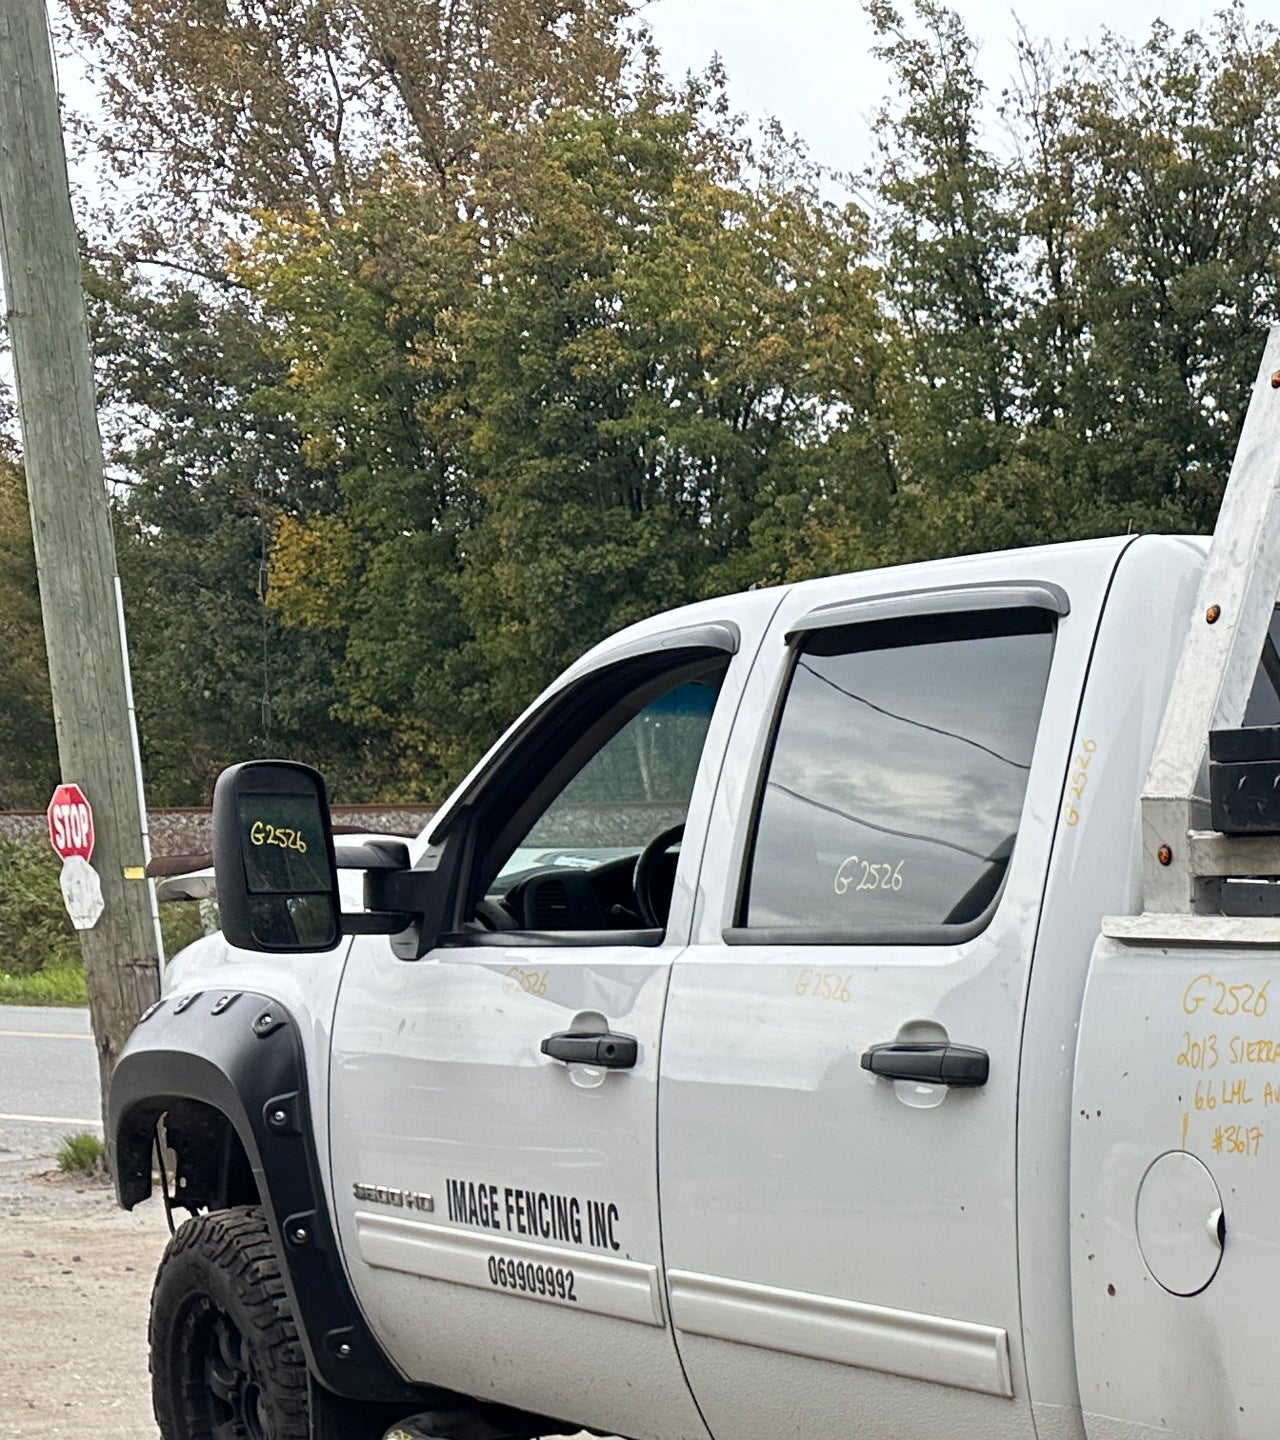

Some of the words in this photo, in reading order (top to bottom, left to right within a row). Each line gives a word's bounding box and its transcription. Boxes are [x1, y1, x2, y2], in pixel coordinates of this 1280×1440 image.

[1064, 738, 1097, 828] G2526
[53, 803, 89, 849] STOP
[250, 821, 307, 853] G2526
[833, 855, 903, 895] G2526
[1182, 974, 1271, 1017] G2526
[1176, 1031, 1219, 1070] 2013
[1212, 1125, 1264, 1157] #3617
[446, 1178, 501, 1230] IMAGE
[504, 1188, 583, 1244] FENCING
[587, 1200, 621, 1251] INC
[488, 1255, 577, 1302] 069909992
